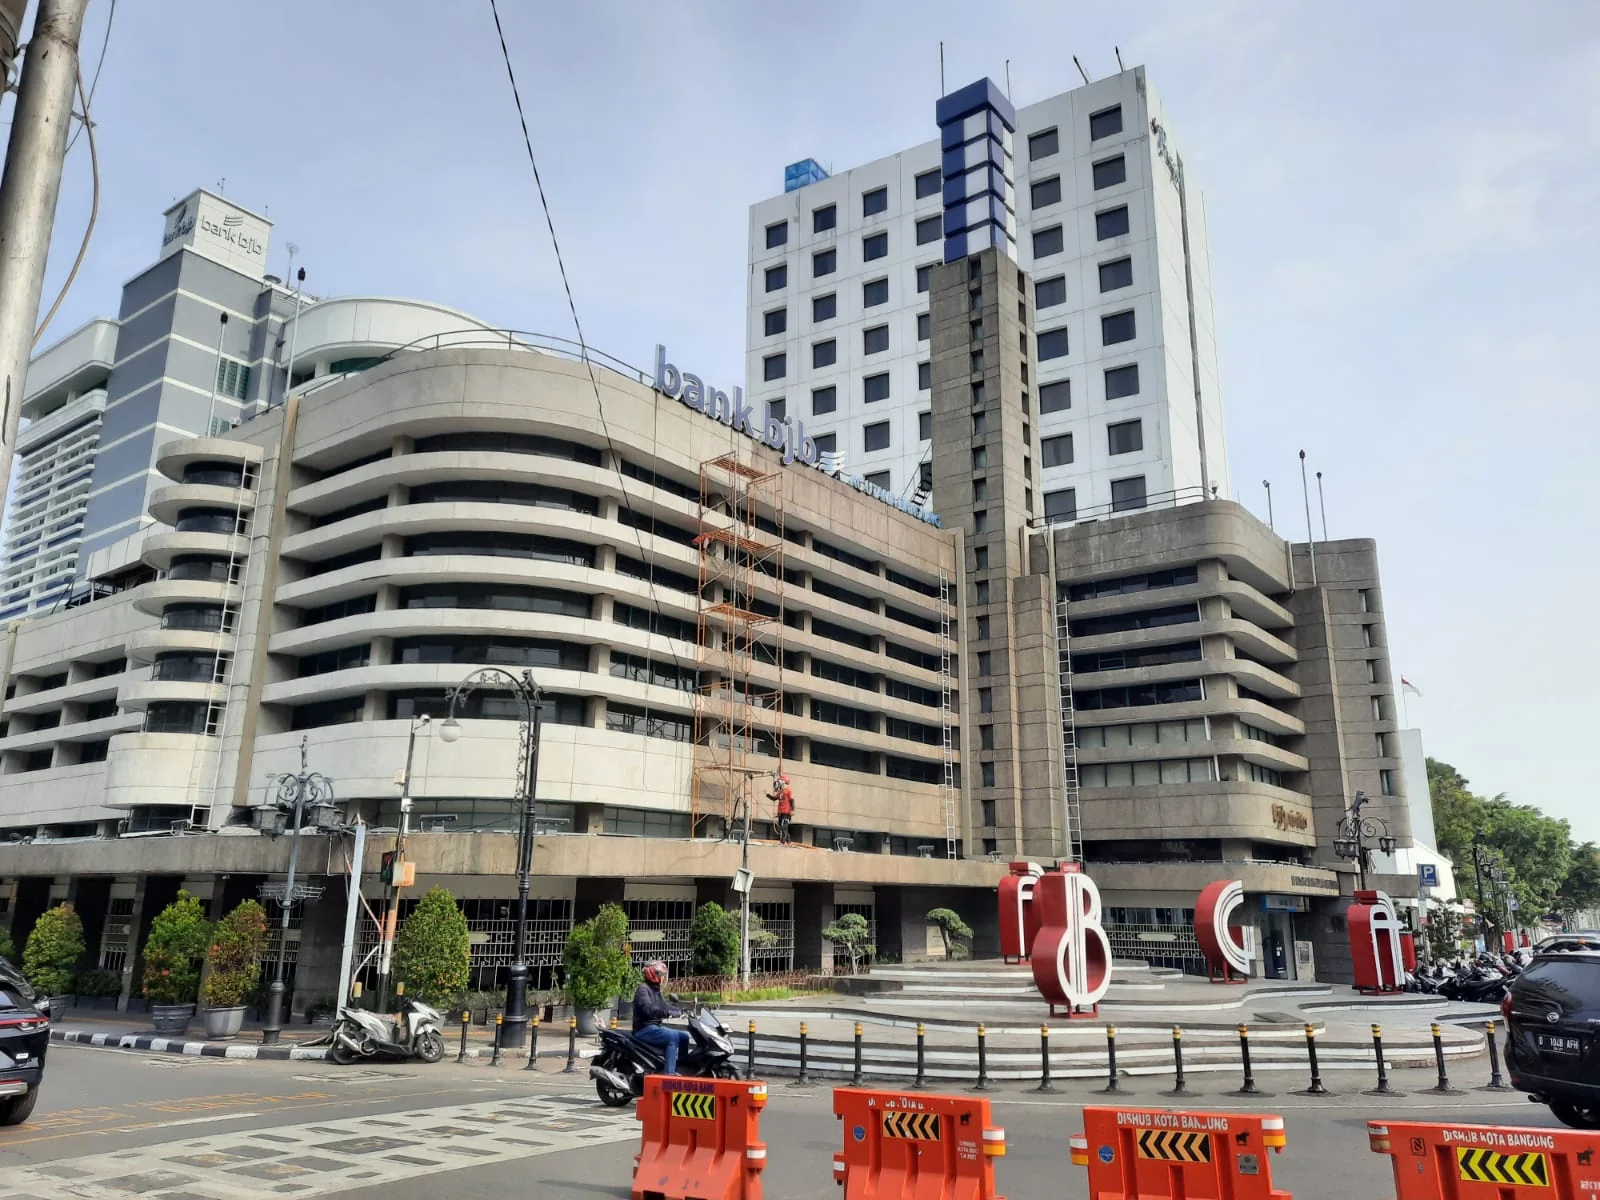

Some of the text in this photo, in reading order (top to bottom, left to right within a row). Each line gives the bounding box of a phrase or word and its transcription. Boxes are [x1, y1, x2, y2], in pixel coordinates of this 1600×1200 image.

[200, 215, 262, 255] bank bjb
[655, 343, 818, 466] bank bjb
[1423, 866, 1434, 878] P
[1153, 1114, 1180, 1128] KOTA
